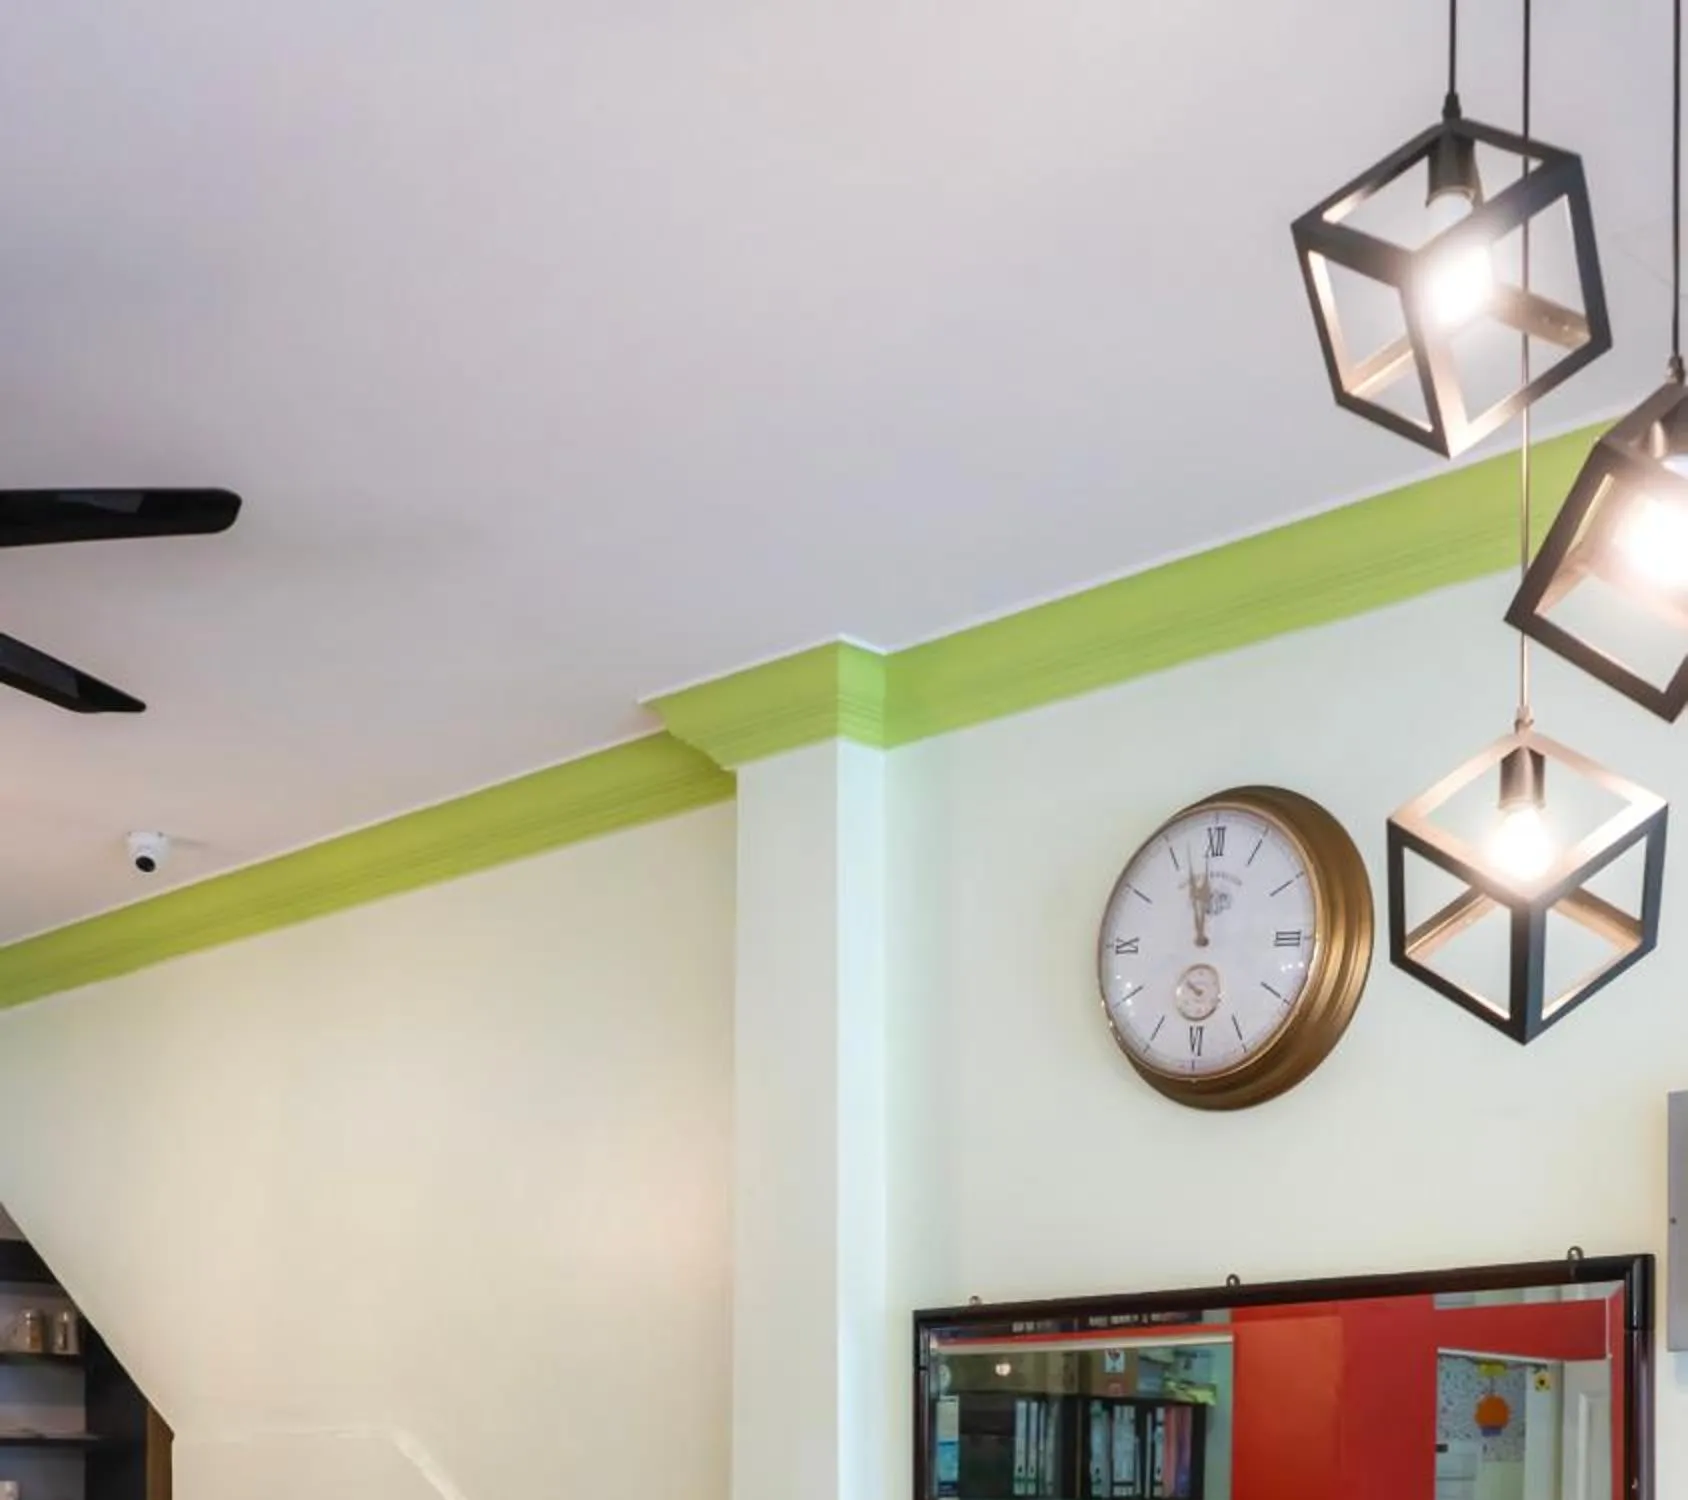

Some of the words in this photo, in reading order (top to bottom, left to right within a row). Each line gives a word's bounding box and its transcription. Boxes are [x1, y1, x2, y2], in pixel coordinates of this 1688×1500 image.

[1206, 826, 1226, 858] XII
[1274, 931, 1301, 947] III
[1189, 1025, 1204, 1057] VI
